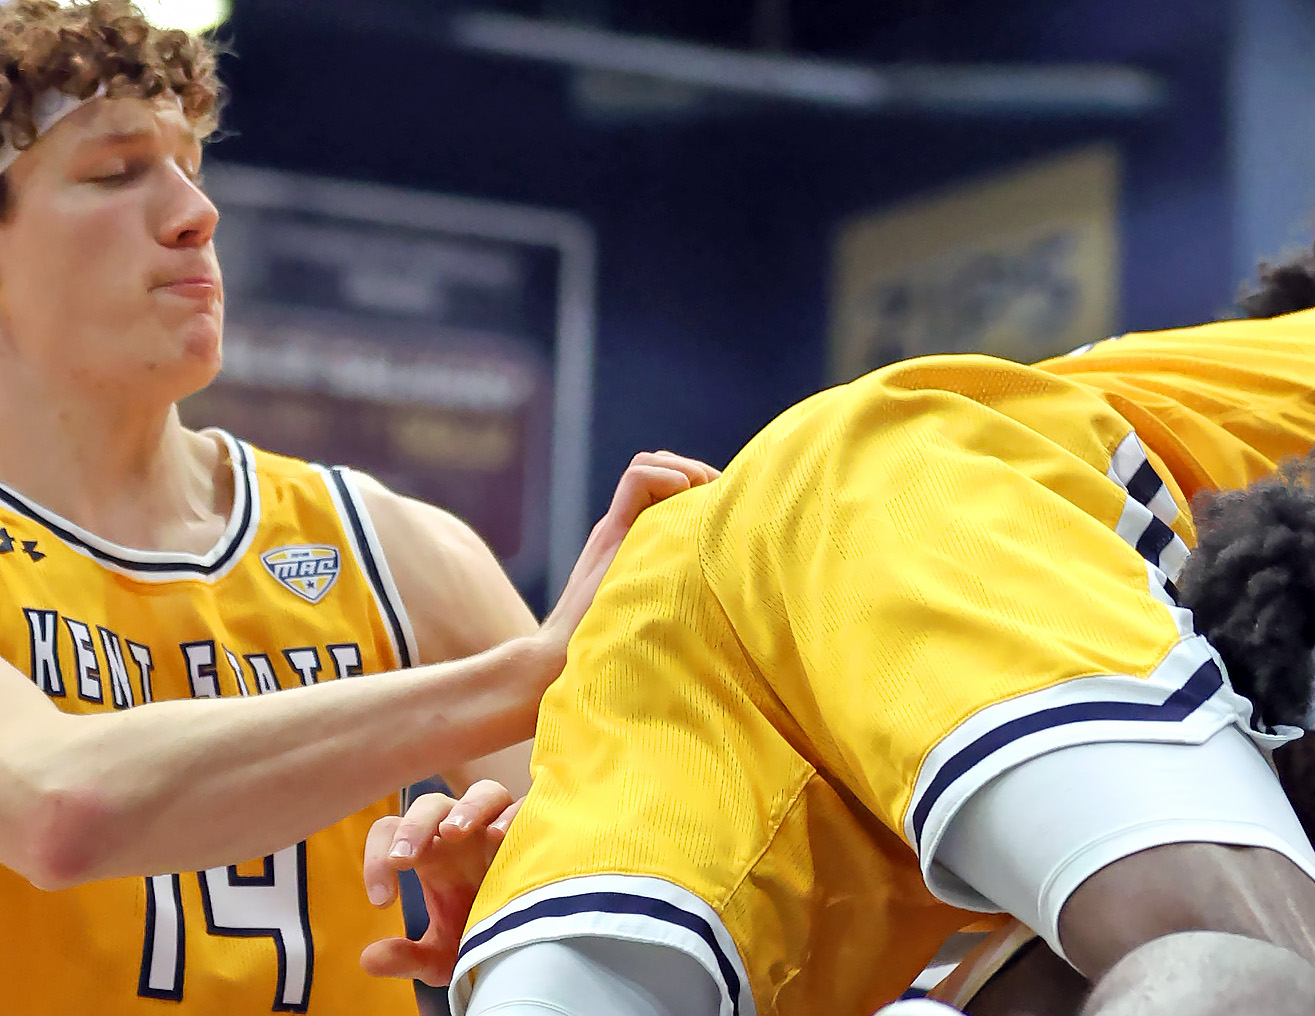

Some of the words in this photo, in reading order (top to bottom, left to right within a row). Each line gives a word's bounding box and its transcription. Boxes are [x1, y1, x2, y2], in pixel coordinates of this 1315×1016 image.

[272, 559, 338, 578] MAC
[22, 607, 154, 709] KENT
[180, 640, 364, 699] SAT
